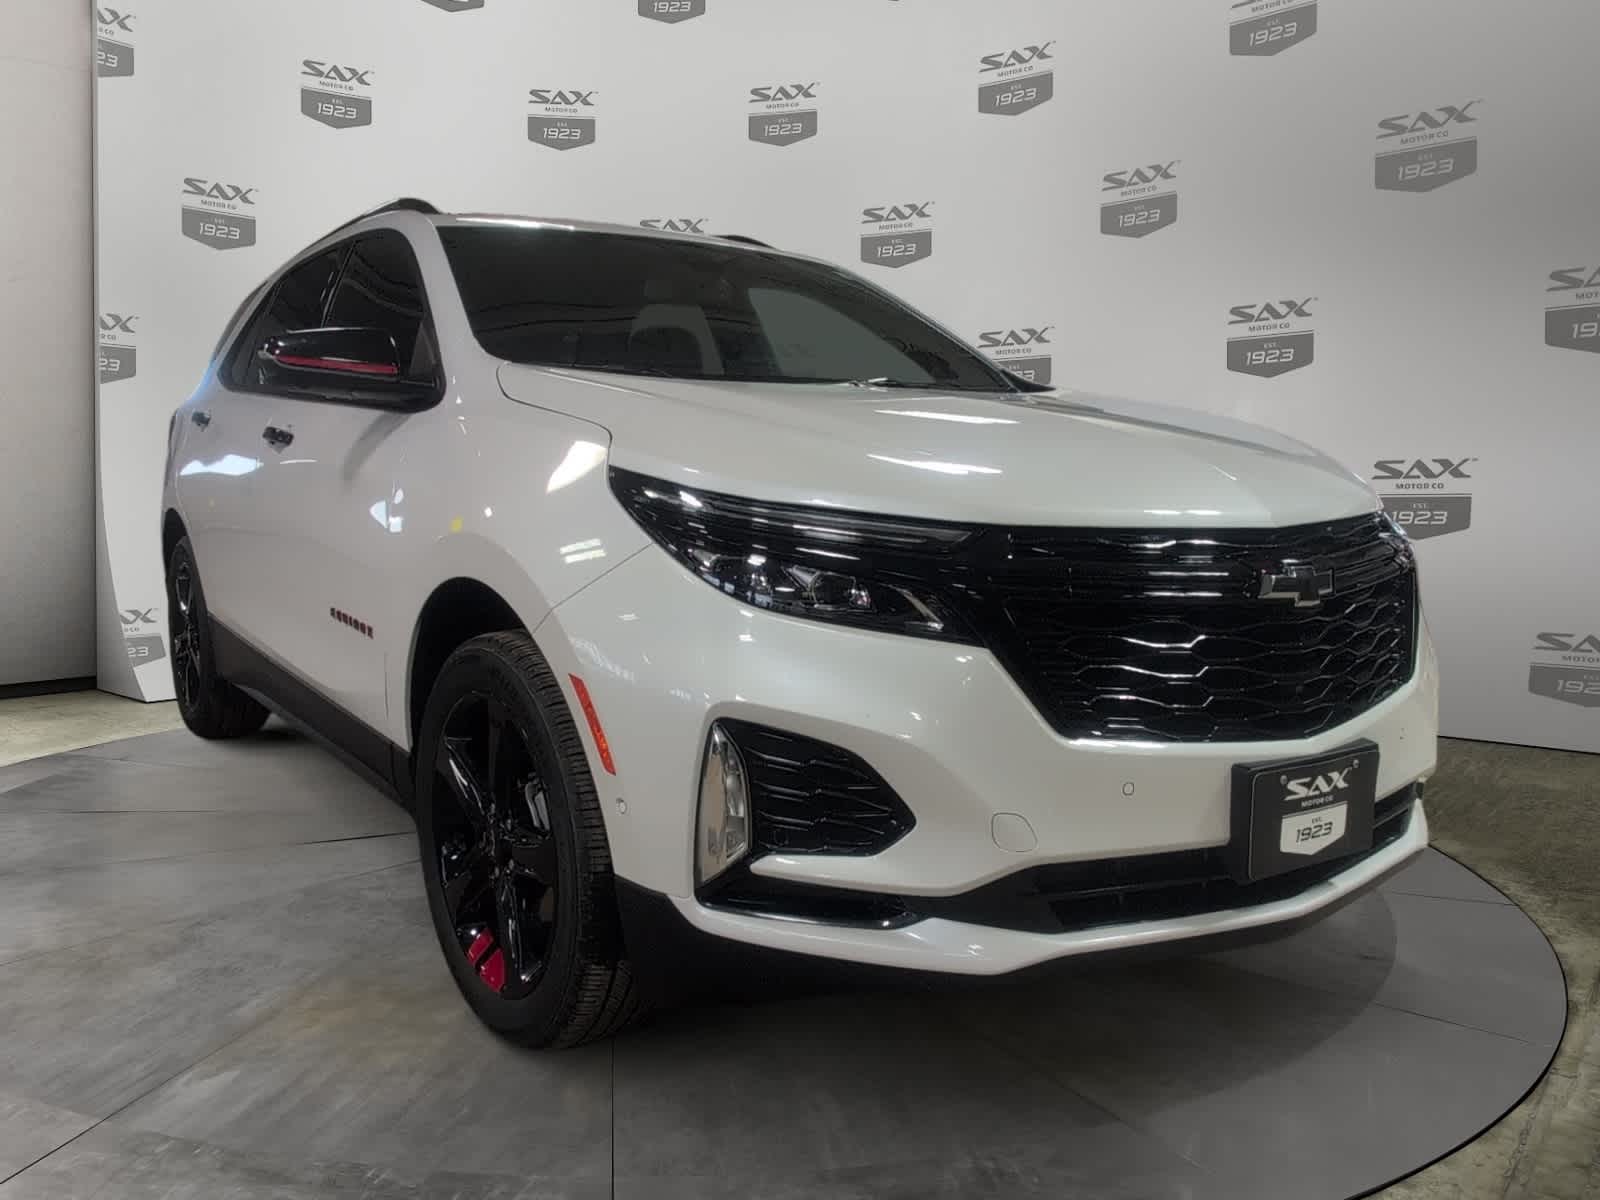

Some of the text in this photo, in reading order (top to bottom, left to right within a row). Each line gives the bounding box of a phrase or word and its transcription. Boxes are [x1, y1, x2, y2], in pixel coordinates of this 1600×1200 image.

[654, 1, 691, 13] 1923
[1250, 22, 1297, 47] 1923
[97, 51, 118, 68] 23
[979, 42, 1053, 74] SAX
[301, 60, 370, 87] SAX
[528, 89, 594, 106] SAX
[749, 82, 816, 104] SAX
[995, 88, 1037, 107] 1923
[317, 102, 357, 119] 1923
[764, 122, 802, 137] 1923
[1376, 101, 1478, 140] SAX
[543, 128, 581, 140] 1923
[1436, 130, 1449, 139] CO
[1101, 162, 1176, 192] SAX
[1398, 158, 1456, 181] 1923
[181, 178, 255, 205] SAX
[861, 202, 932, 225] SAX
[1119, 209, 1161, 228] 1923
[199, 222, 241, 240] 1923
[639, 218, 704, 234] SAX
[877, 243, 917, 258] 1923
[1227, 298, 1313, 326] SAX
[1280, 321, 1290, 329] CO
[1572, 323, 1600, 339] 19
[977, 327, 1051, 349] SAX
[98, 358, 120, 372] 23
[1246, 349, 1294, 366] 1923
[1372, 459, 1471, 480] SAX
[1391, 511, 1449, 525] 1923
[1534, 632, 1600, 653] SA
[127, 646, 149, 658] 23
[1557, 680, 1600, 695] 192
[1284, 767, 1352, 801] SAX
[1296, 821, 1333, 843] 1923
